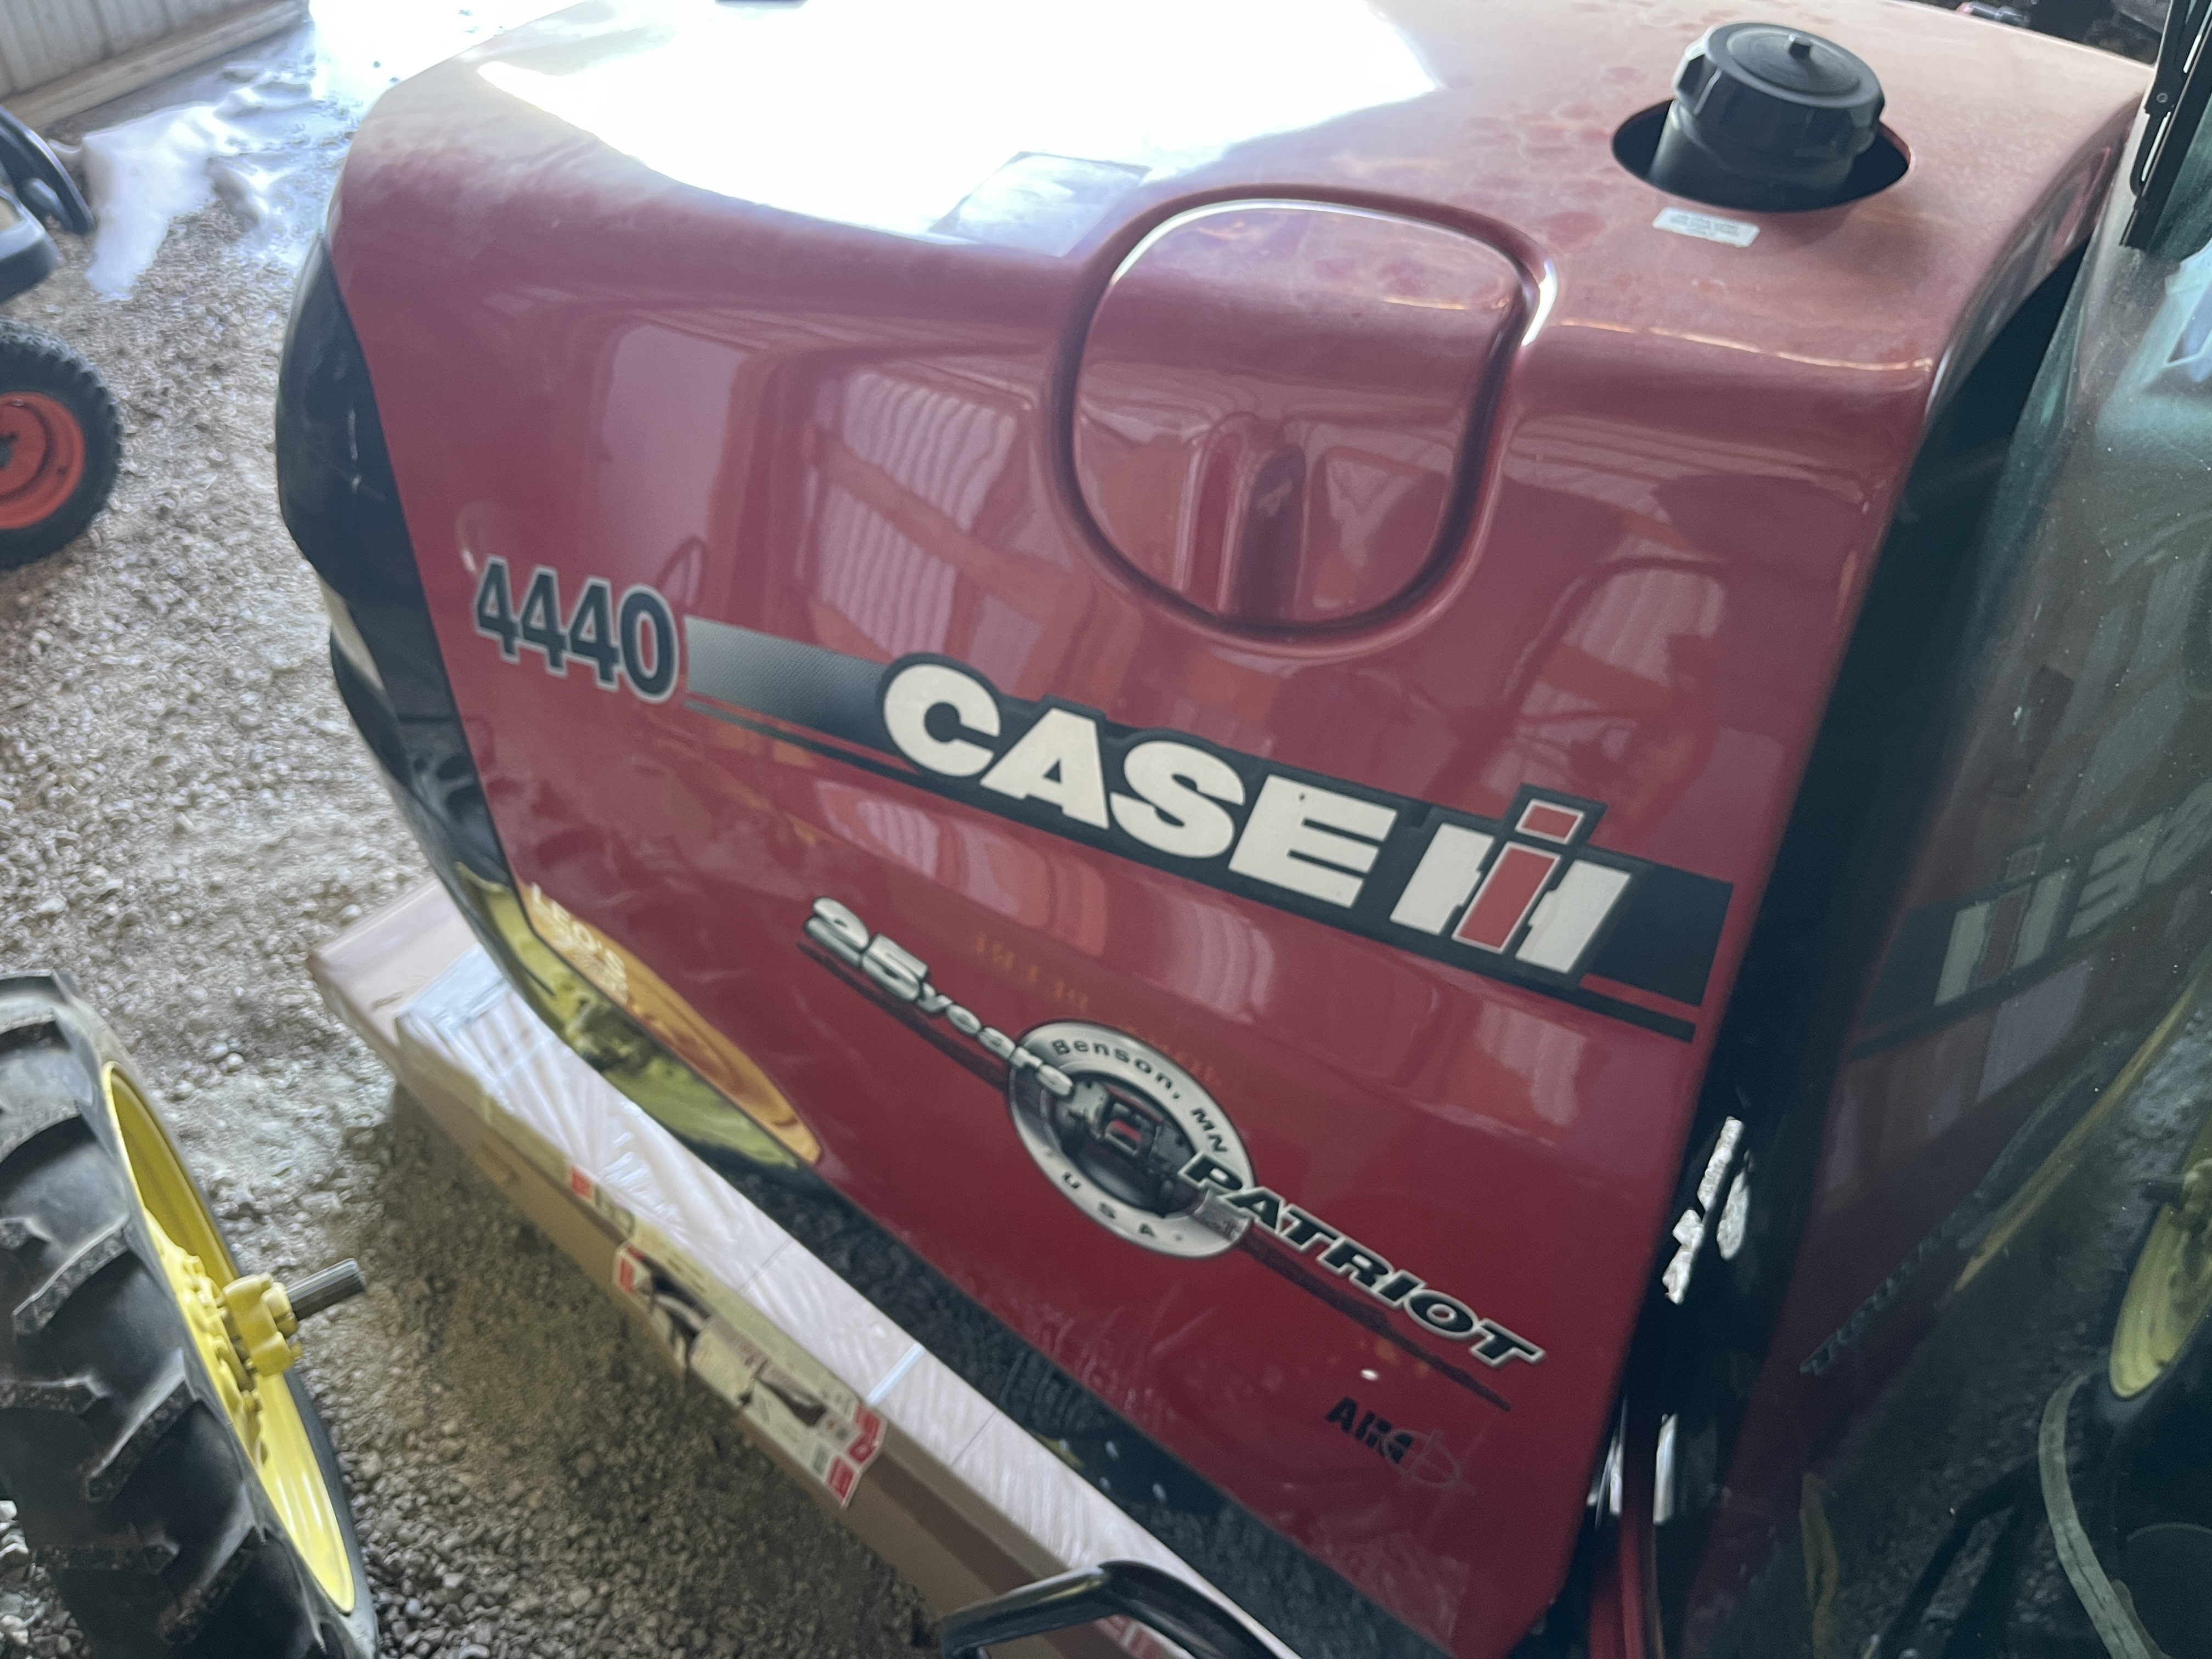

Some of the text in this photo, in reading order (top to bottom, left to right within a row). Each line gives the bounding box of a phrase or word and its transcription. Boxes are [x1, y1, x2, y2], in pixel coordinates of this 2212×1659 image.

[475, 556, 680, 703] 4440
[883, 663, 1631, 974] CASE IH
[1051, 1039, 1228, 1152] Benson, MN
[1178, 1153, 1546, 1368] PATRIOT
